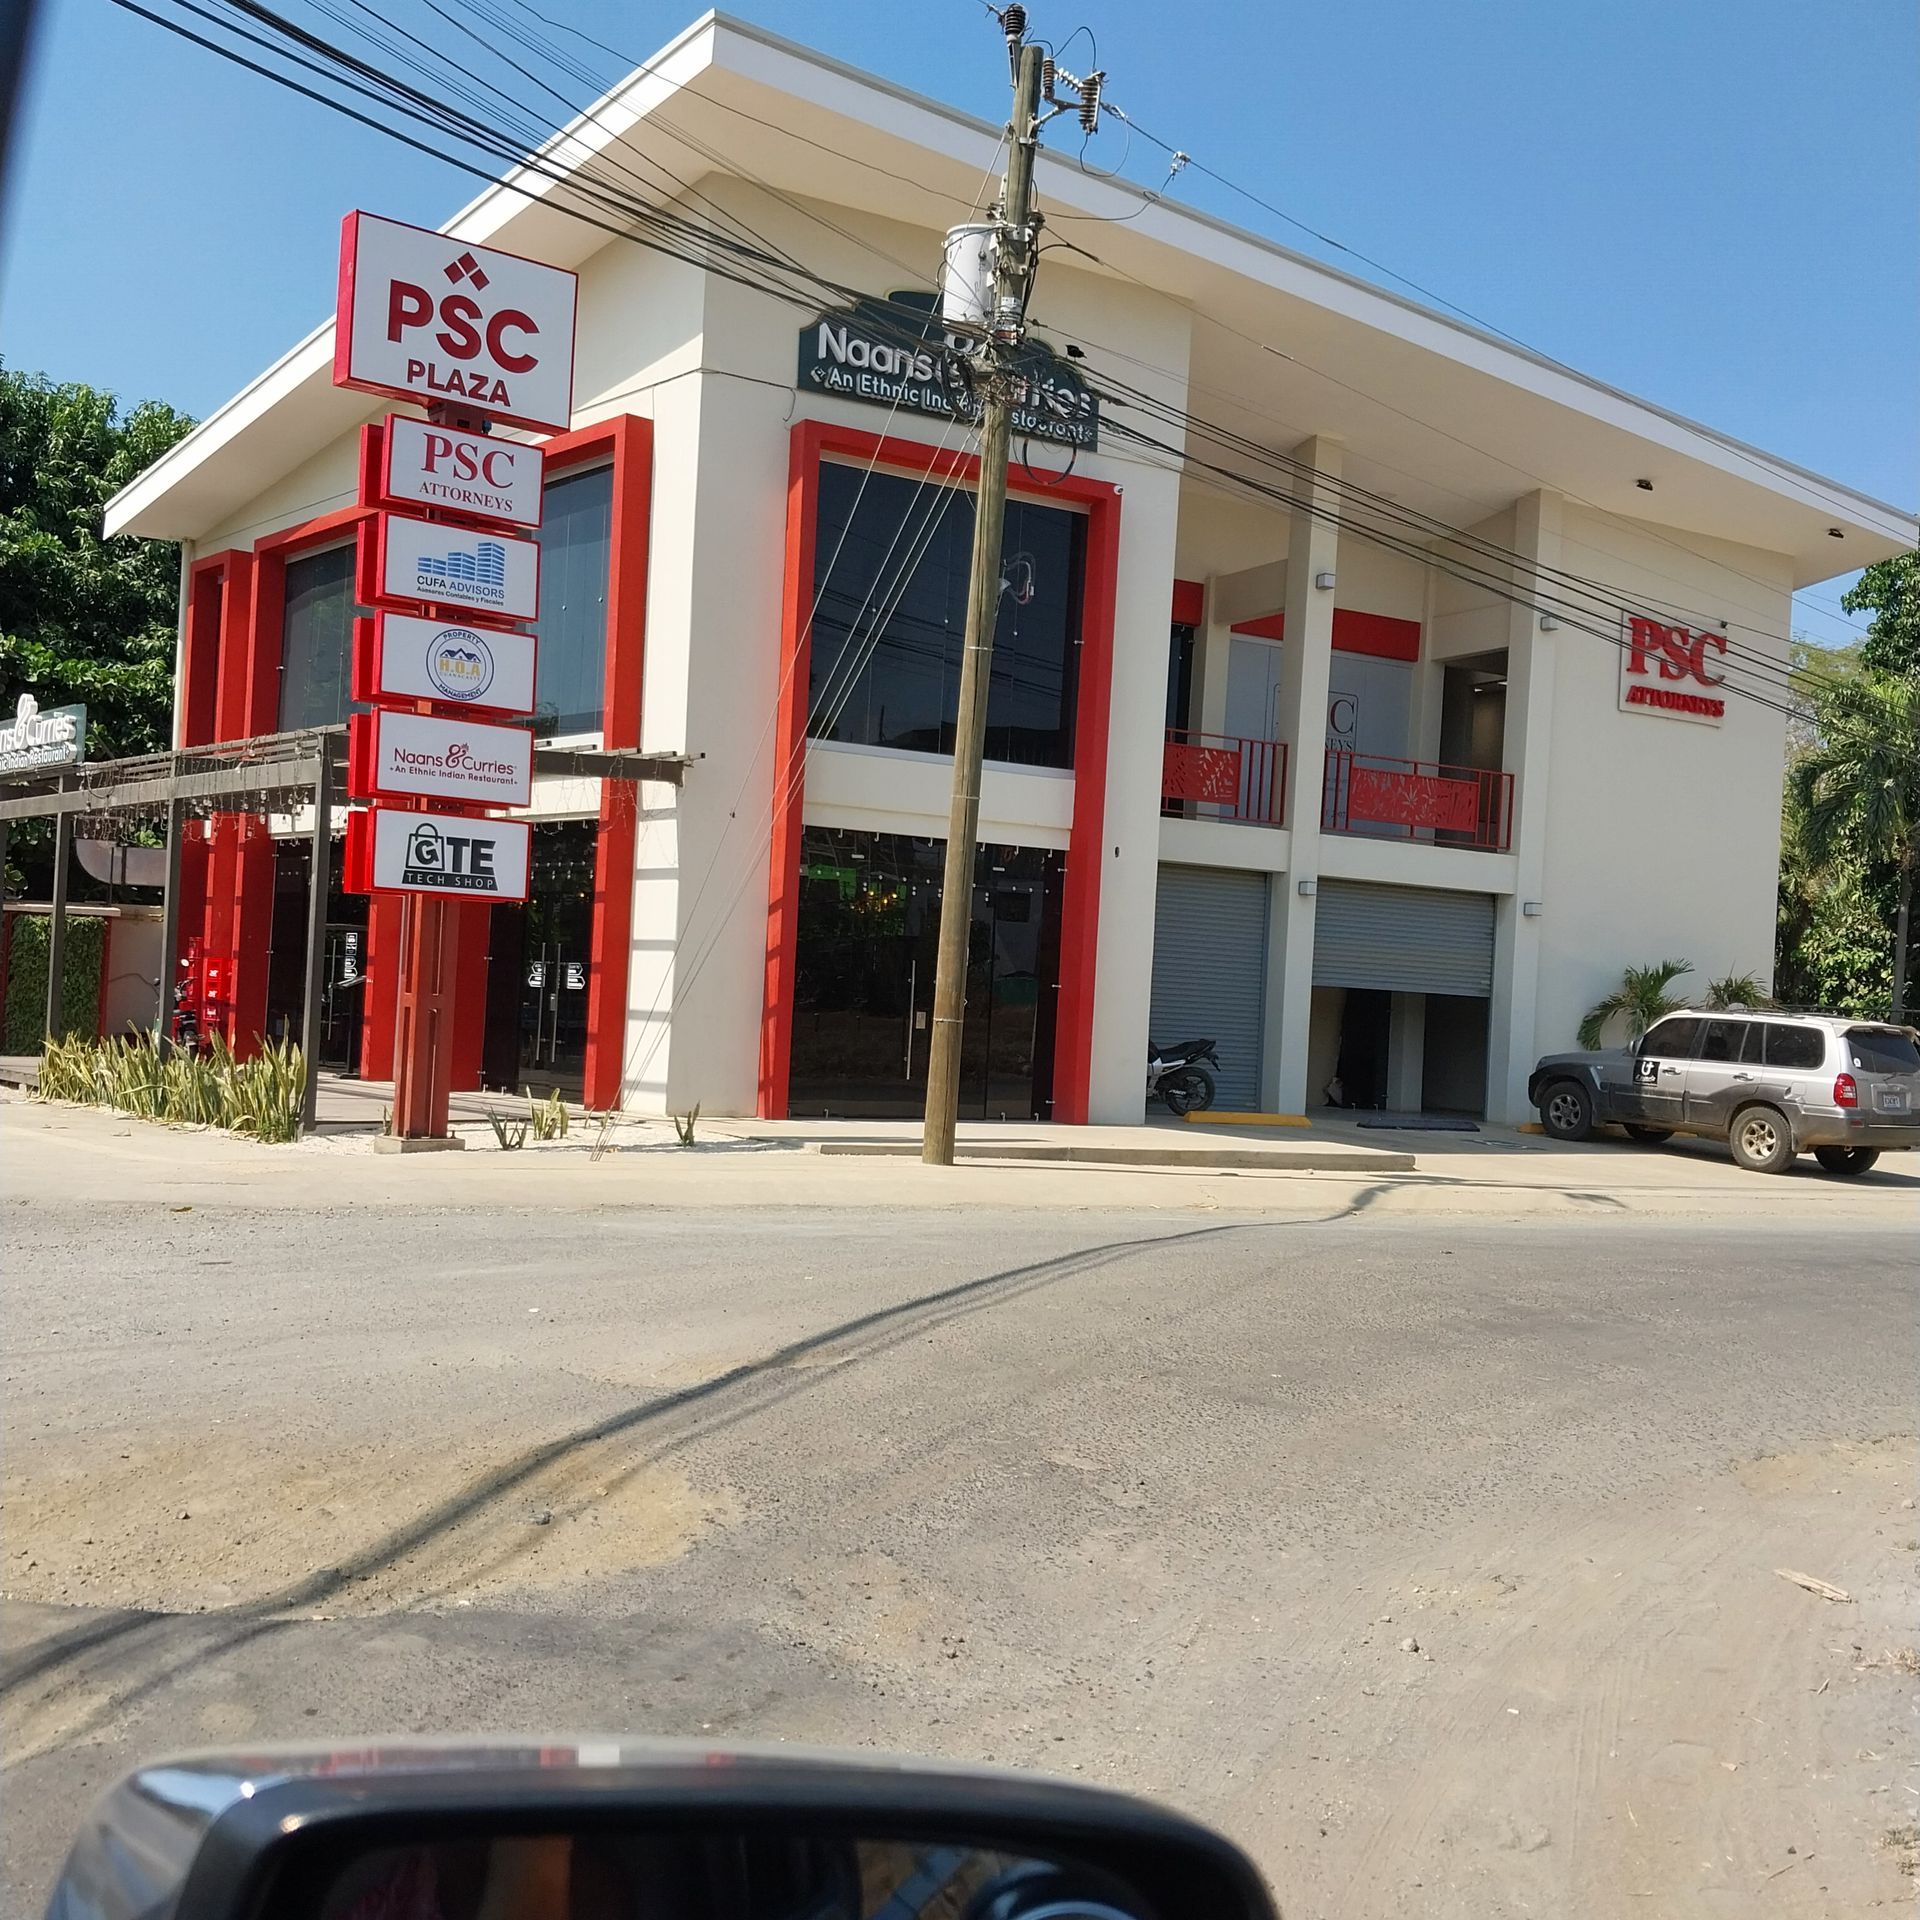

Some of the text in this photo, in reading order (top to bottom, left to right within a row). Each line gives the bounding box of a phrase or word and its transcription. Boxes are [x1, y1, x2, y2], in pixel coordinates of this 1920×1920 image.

[387, 279, 540, 374] PSC
[818, 322, 933, 381] Naans
[406, 358, 512, 407] PLAZA
[829, 367, 854, 388] An
[860, 373, 920, 402] Ethnic
[420, 432, 515, 489] PSC
[418, 480, 514, 513] ATTORNEYS
[416, 575, 505, 599] CUFA ADVISORS
[416, 586, 445, 596] Asesores
[445, 591, 475, 601] Contables
[480, 597, 504, 606] Fiscales
[443, 631, 481, 645] PROPERTY
[1626, 617, 1727, 687] PSC
[438, 683, 482, 699] MANAGEMENT
[393, 743, 514, 775] Naans & Curries
[394, 765, 514, 785] An Ethnic Indian Restaurant
[413, 836, 497, 876] GTE
[406, 872, 494, 888] TECH SHOP
